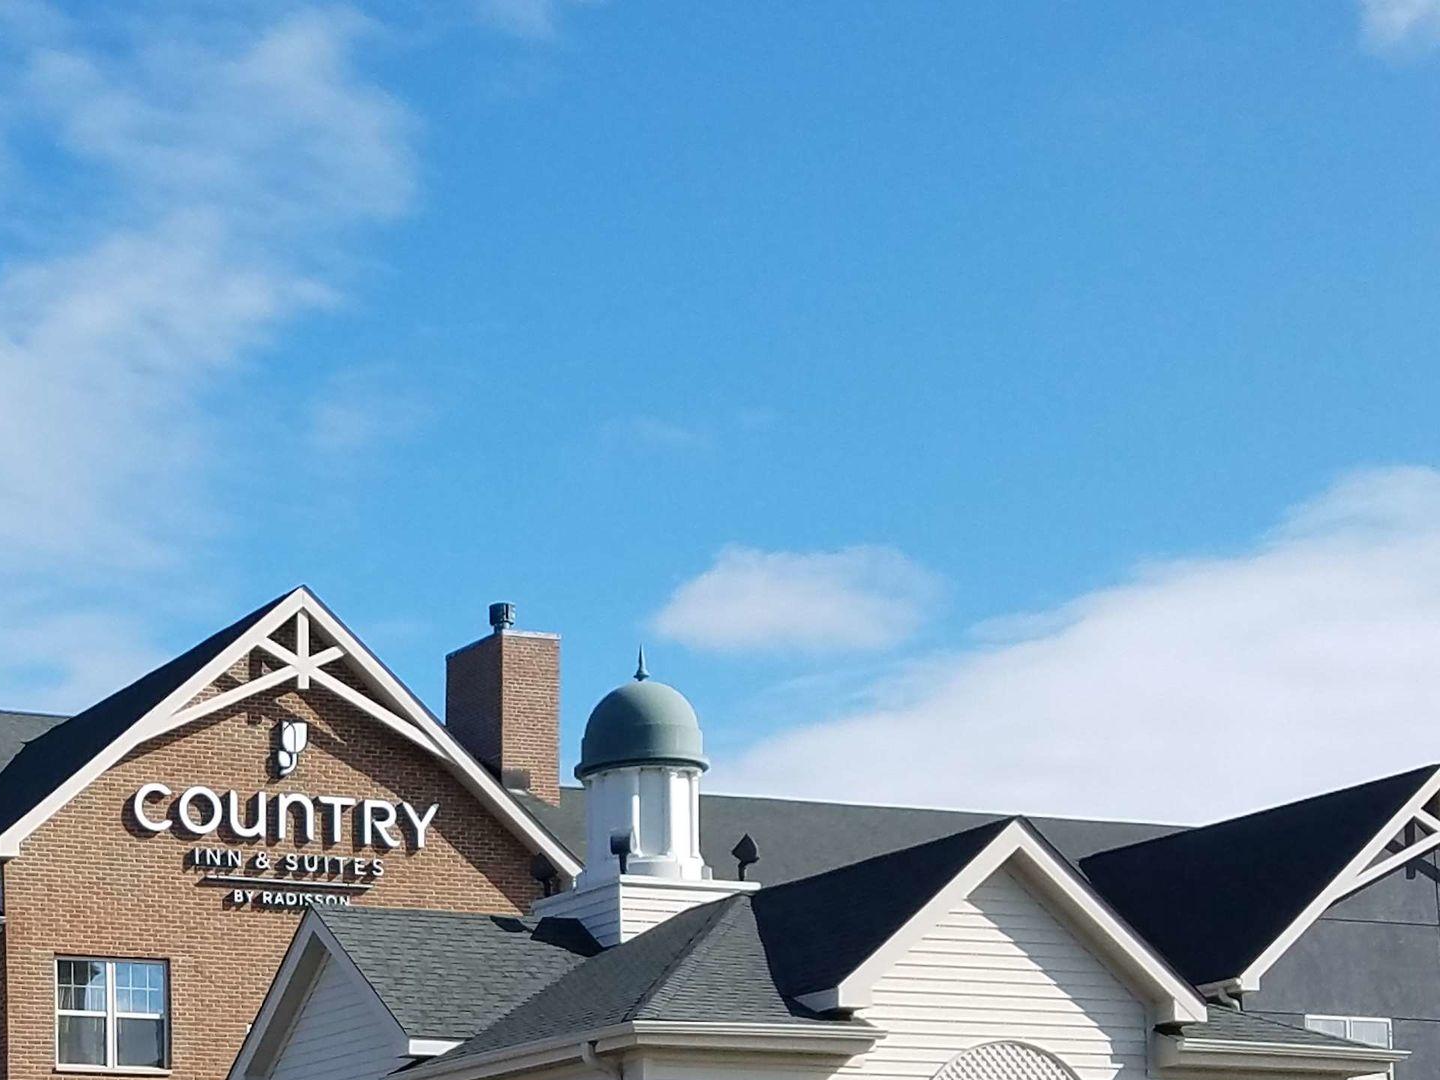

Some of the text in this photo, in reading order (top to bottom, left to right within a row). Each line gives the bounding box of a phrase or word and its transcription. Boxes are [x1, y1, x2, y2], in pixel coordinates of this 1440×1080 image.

[133, 782, 440, 849] COUNTRY
[194, 847, 385, 877] INN & SUITES
[233, 889, 350, 906] BY RADISSON
